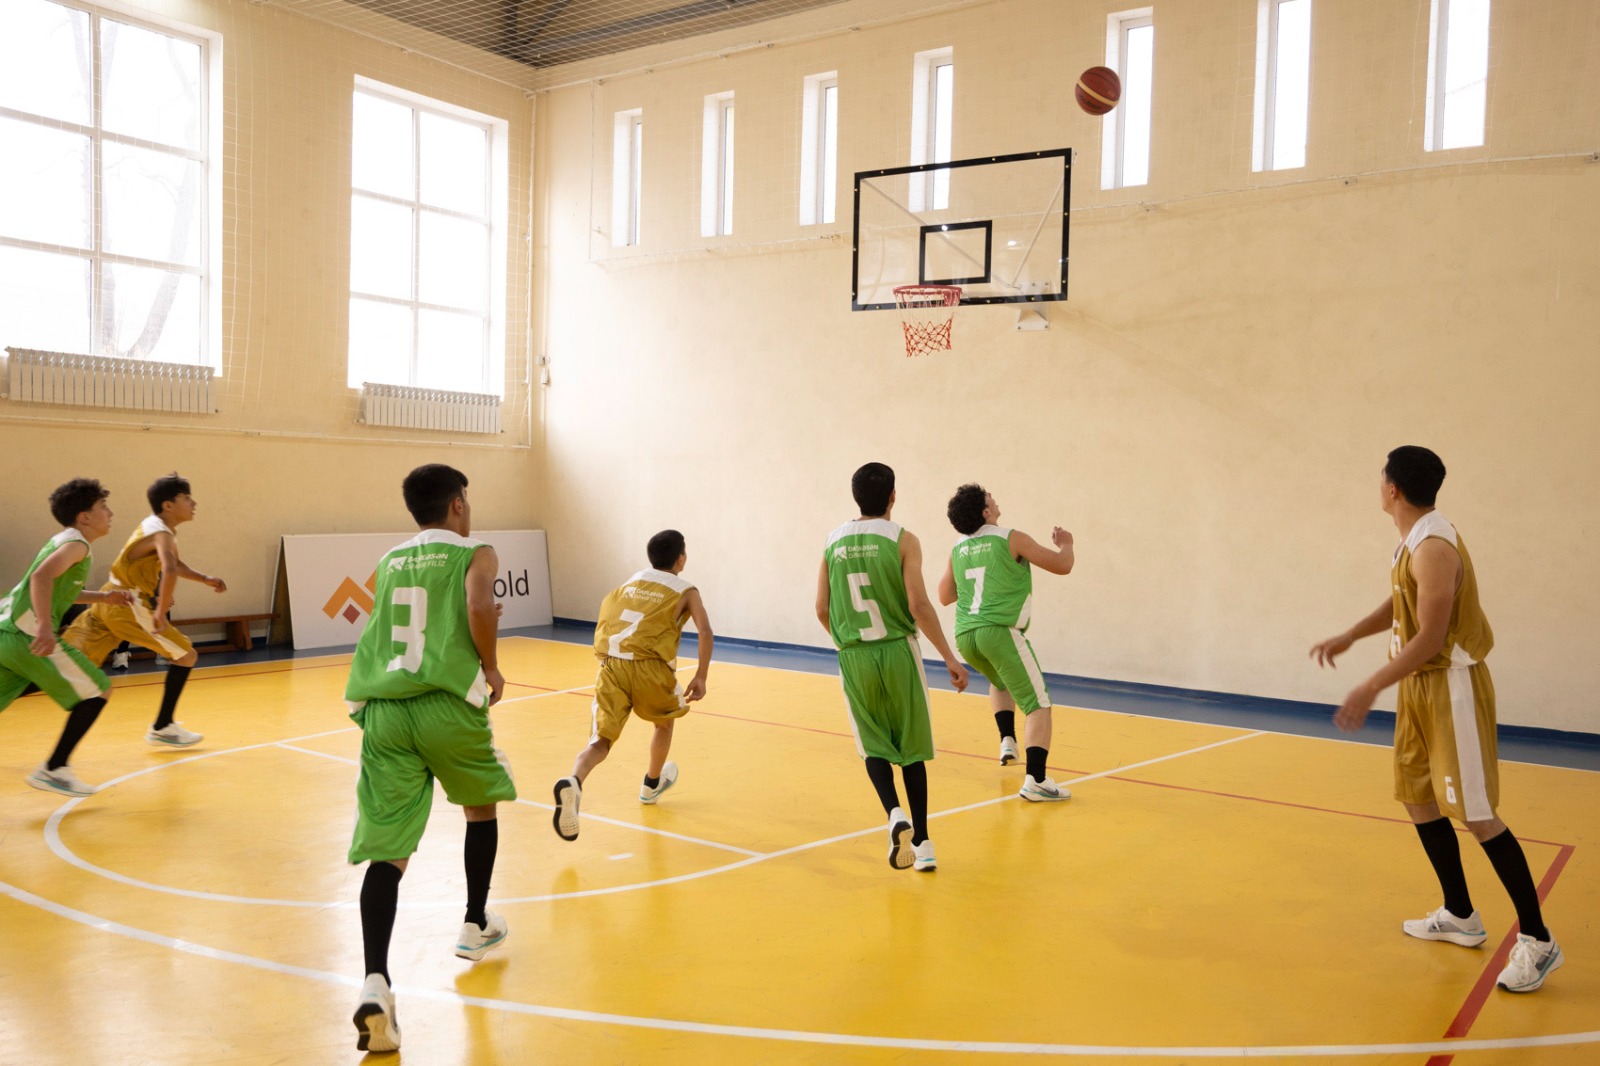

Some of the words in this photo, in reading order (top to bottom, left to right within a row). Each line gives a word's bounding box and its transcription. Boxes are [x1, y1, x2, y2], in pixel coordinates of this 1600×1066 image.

[493, 569, 530, 599] old
[847, 572, 888, 641] 5
[965, 566, 986, 615] 7
[386, 586, 428, 674] 3
[608, 608, 645, 661] 2
[1444, 775, 1457, 804] 6
